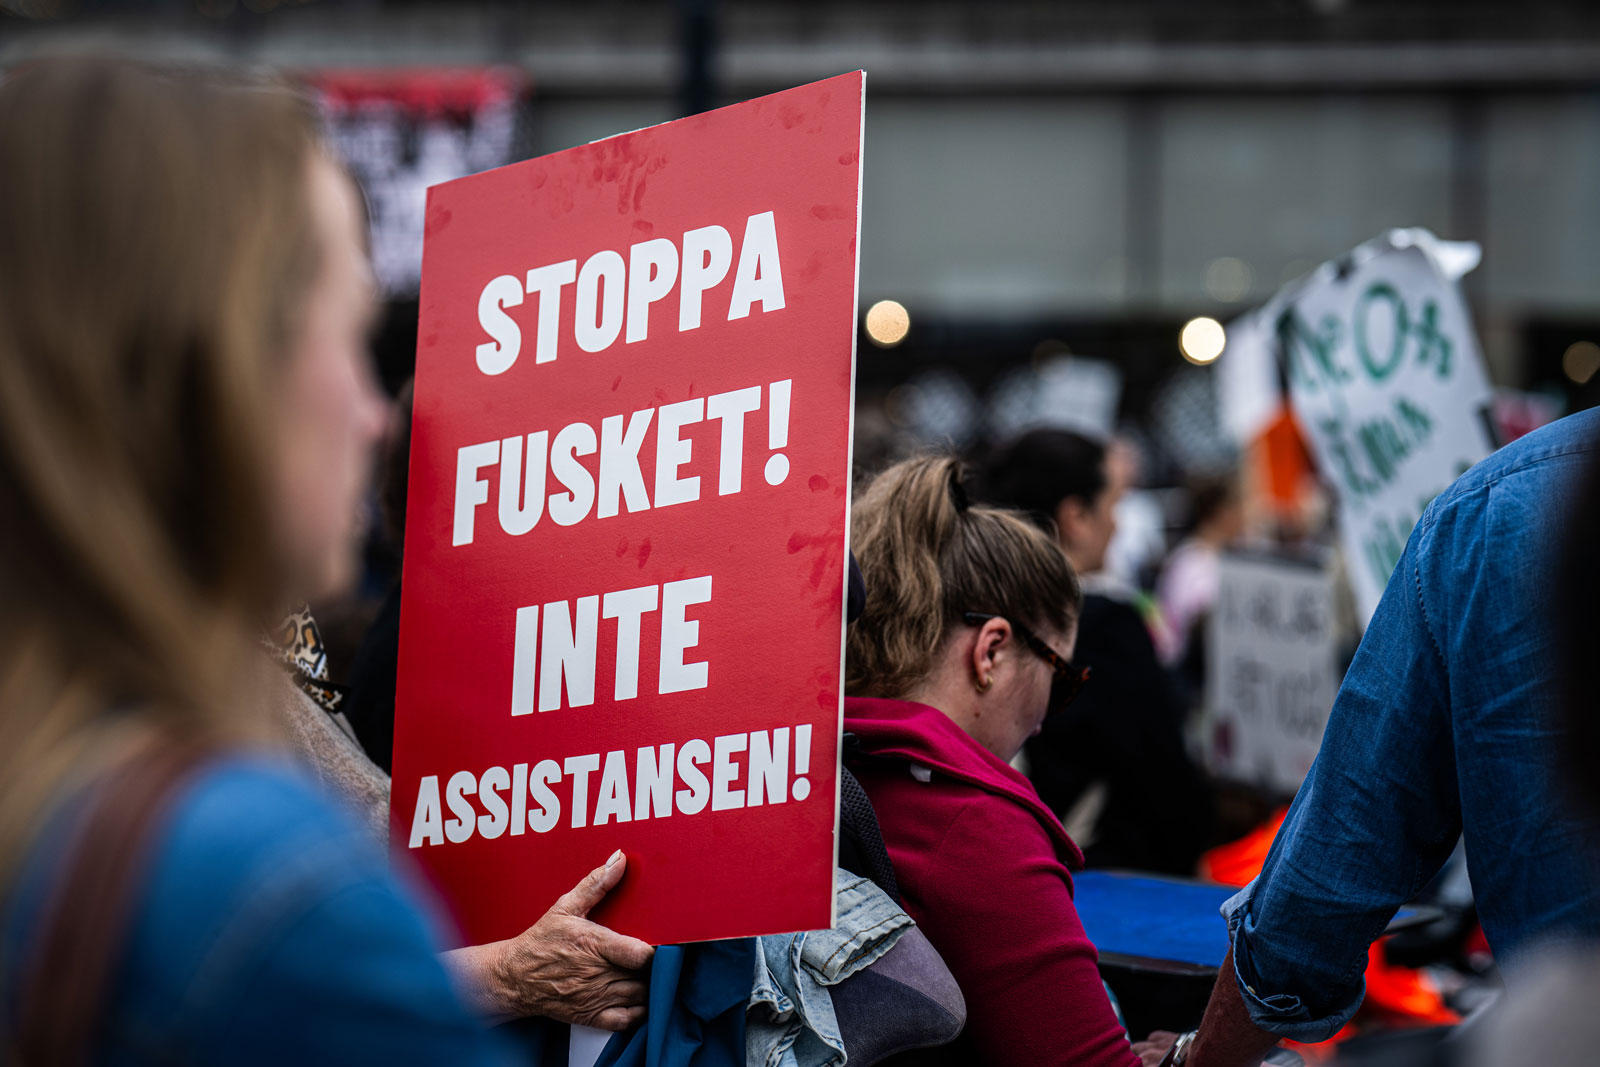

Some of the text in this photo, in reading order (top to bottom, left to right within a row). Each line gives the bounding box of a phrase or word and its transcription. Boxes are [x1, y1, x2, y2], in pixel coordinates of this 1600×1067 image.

[475, 211, 786, 376] STOPPA
[452, 379, 792, 547] FUSKET!
[511, 575, 713, 717] INTE
[408, 724, 813, 849] ASSISTANSEN!
